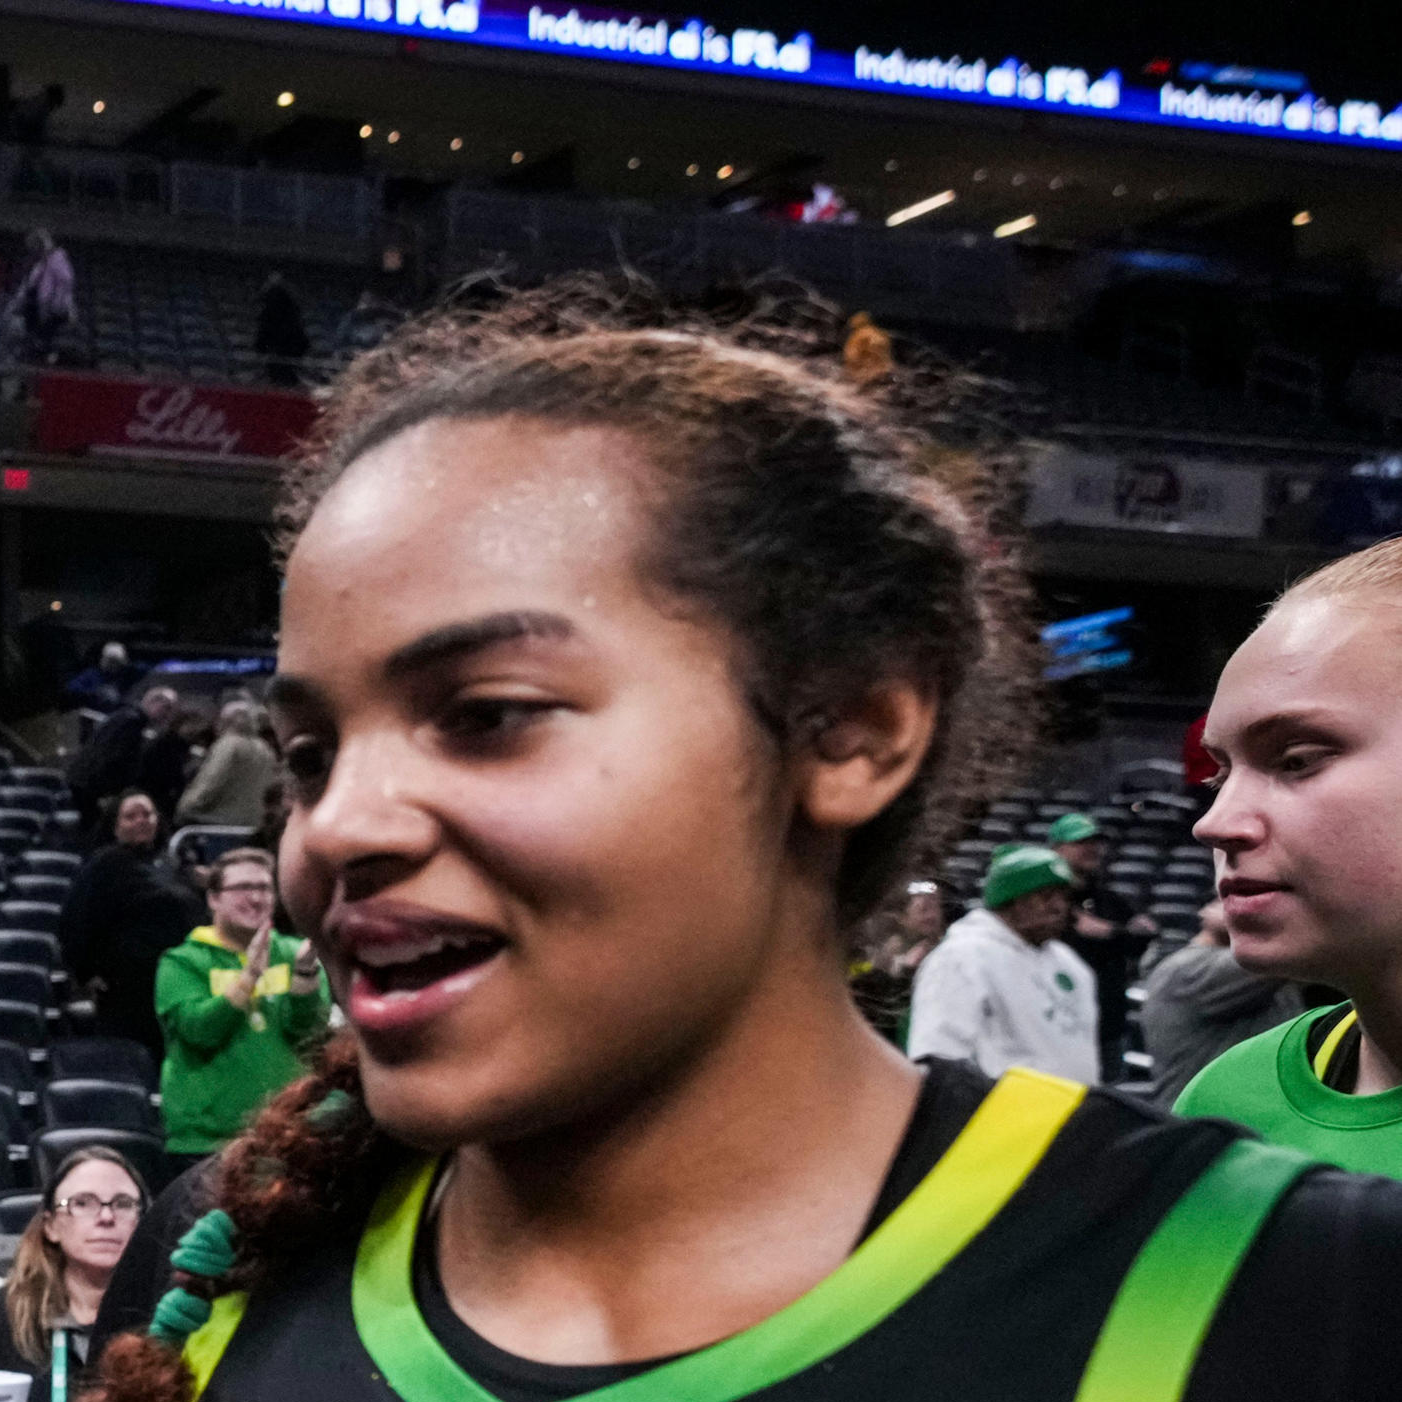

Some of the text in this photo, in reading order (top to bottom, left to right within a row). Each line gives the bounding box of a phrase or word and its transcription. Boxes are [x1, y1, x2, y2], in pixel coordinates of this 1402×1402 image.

[528, 6, 668, 55] Industrial
[702, 26, 730, 63] is
[854, 45, 987, 93] Industrial
[1017, 63, 1044, 100] is
[1160, 81, 1285, 127] Industrial
